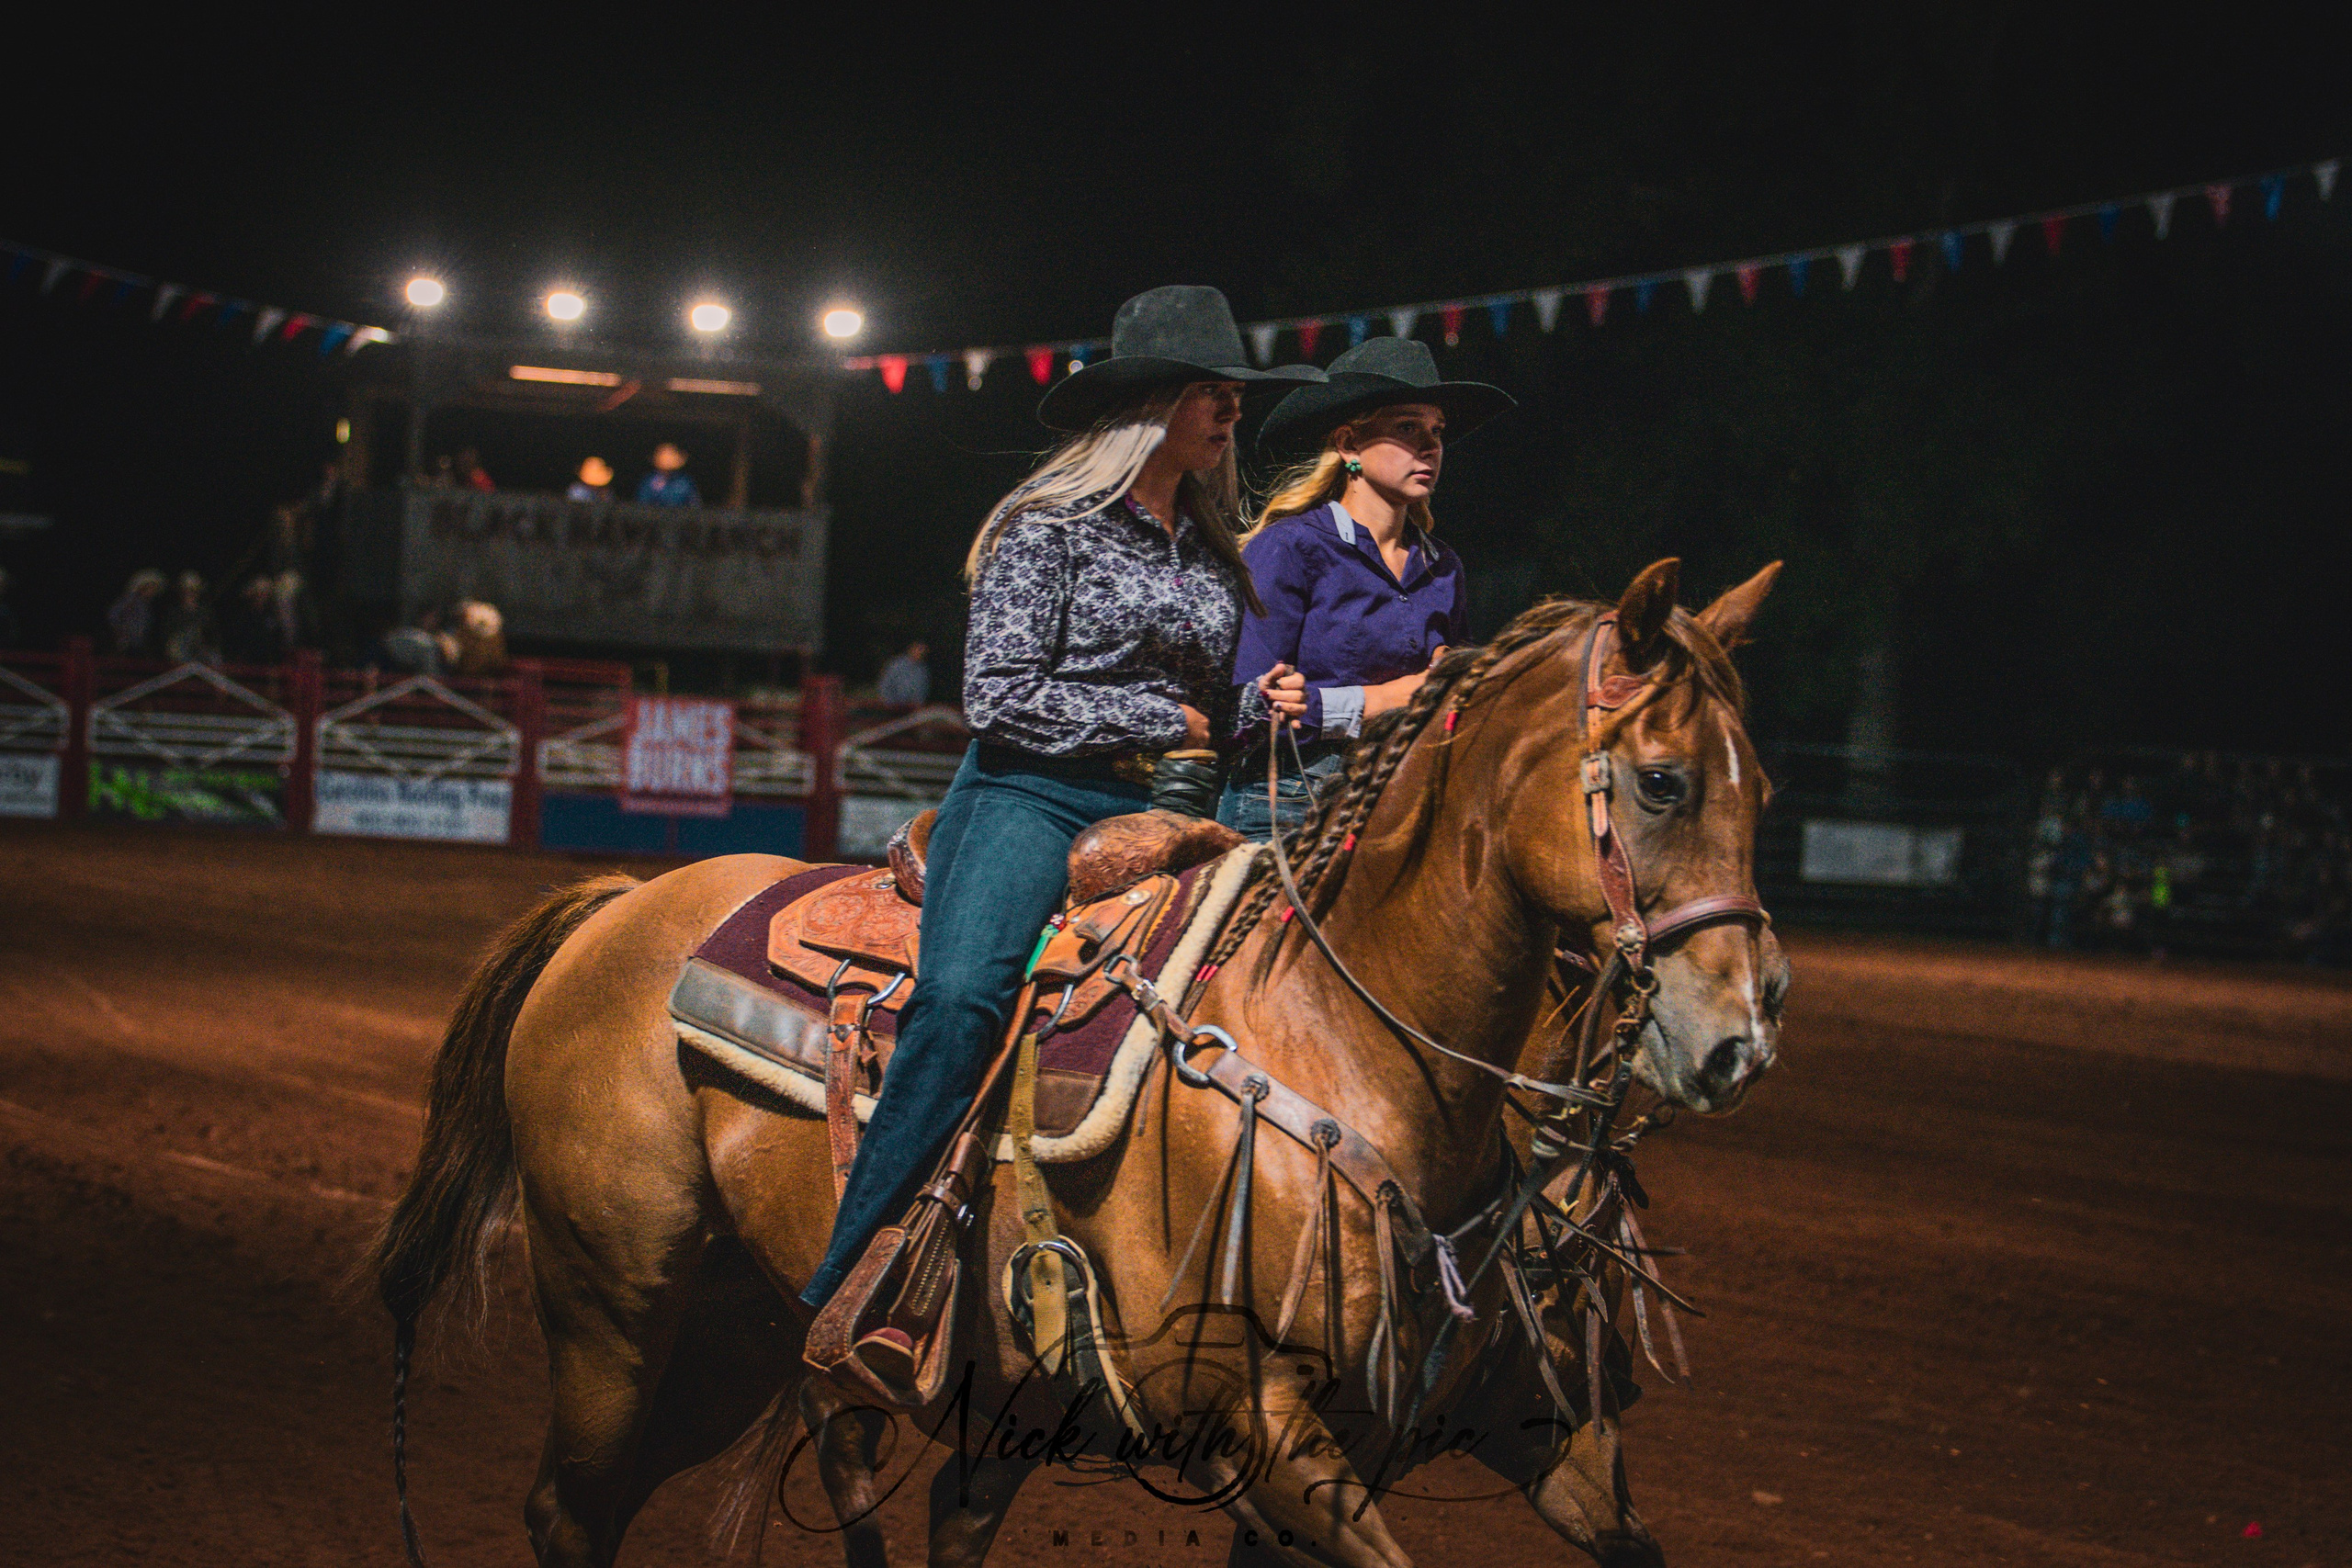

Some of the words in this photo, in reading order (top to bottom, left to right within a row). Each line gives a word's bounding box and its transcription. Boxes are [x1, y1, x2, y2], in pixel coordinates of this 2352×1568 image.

[430, 500, 555, 546] BLACK
[680, 519, 803, 558] RANCH
[639, 698, 731, 745] JAMES
[629, 740, 729, 795] BURNS
